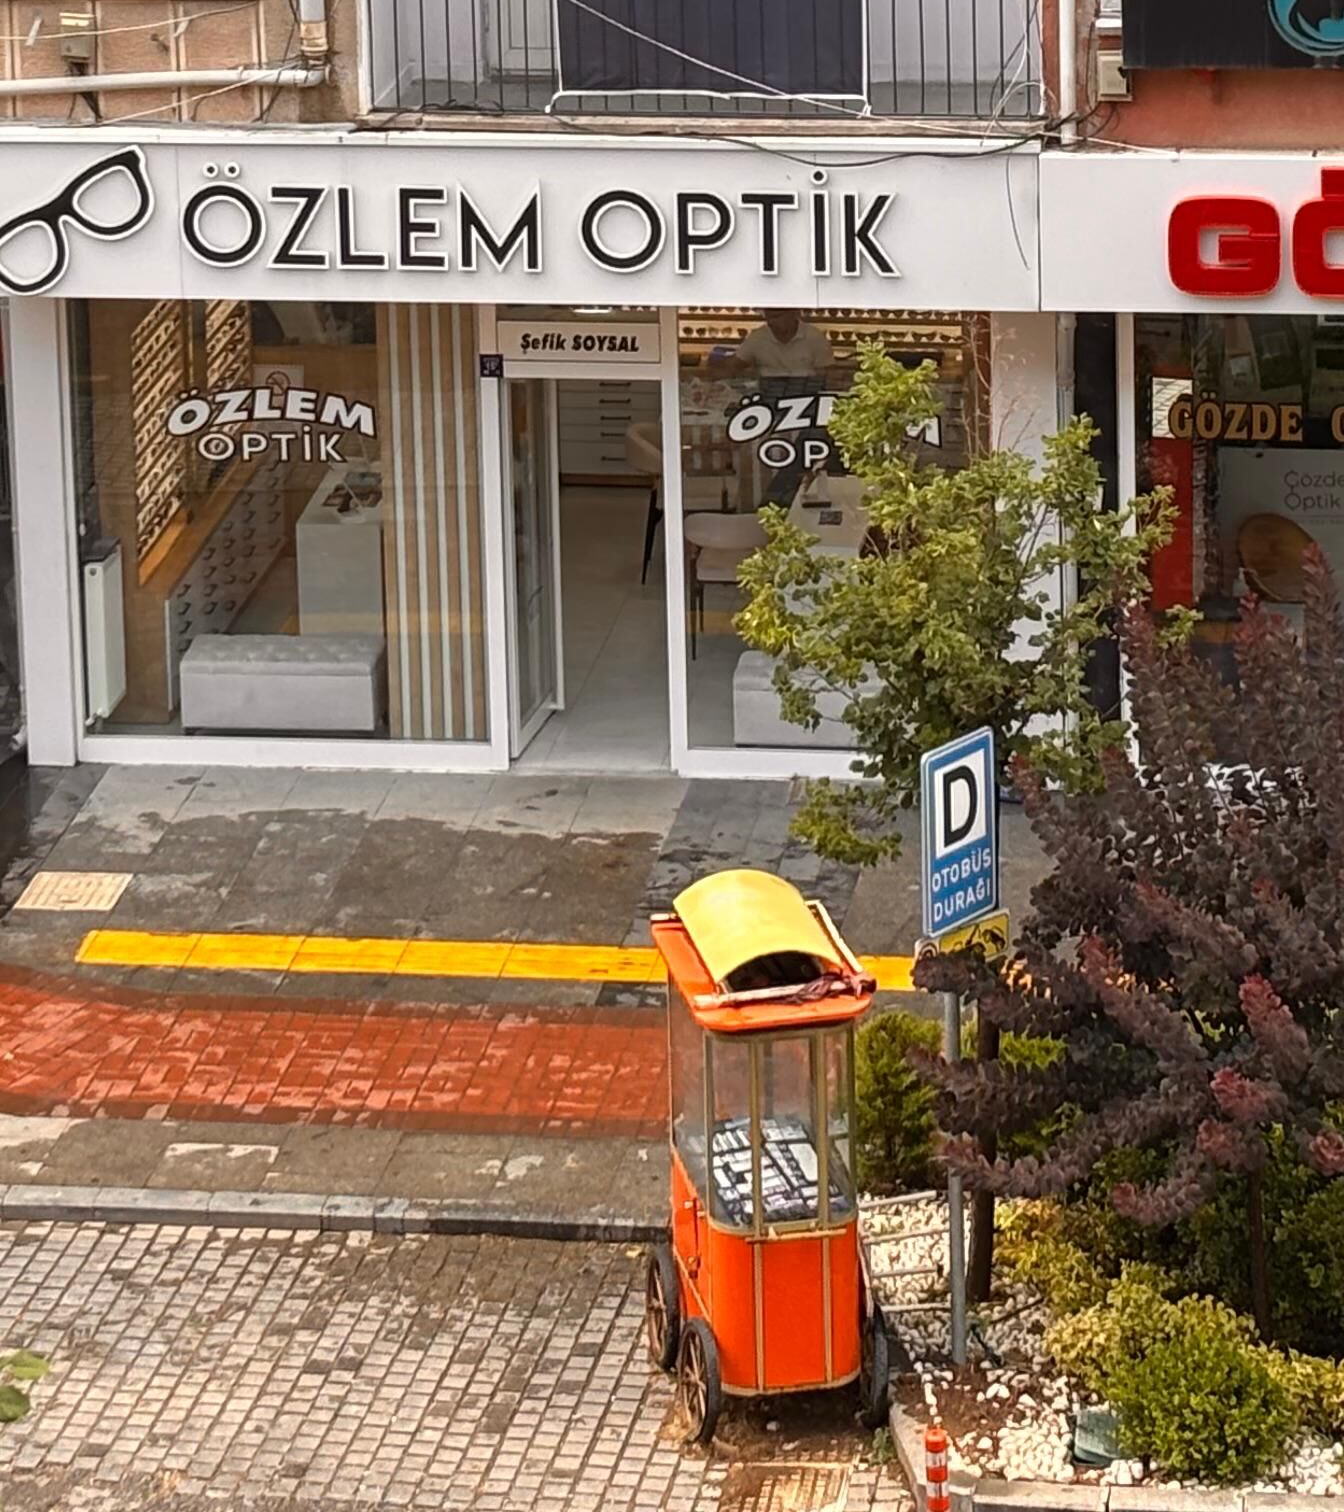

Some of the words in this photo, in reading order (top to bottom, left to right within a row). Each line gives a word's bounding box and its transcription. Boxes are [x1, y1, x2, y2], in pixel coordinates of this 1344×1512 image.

[181, 161, 542, 273] ÖZLEM
[576, 168, 903, 277] OPTİK
[520, 333, 566, 355] Şefik
[571, 335, 639, 353] SOYSAL
[167, 388, 377, 438] ÖZLEM
[1168, 391, 1304, 443] GÖZDE
[197, 423, 347, 463] OPTİK
[1283, 492, 1342, 512] Optik
[942, 764, 978, 848] D
[931, 847, 992, 893] OTOBÜS
[933, 878, 992, 923] DURAĞI
